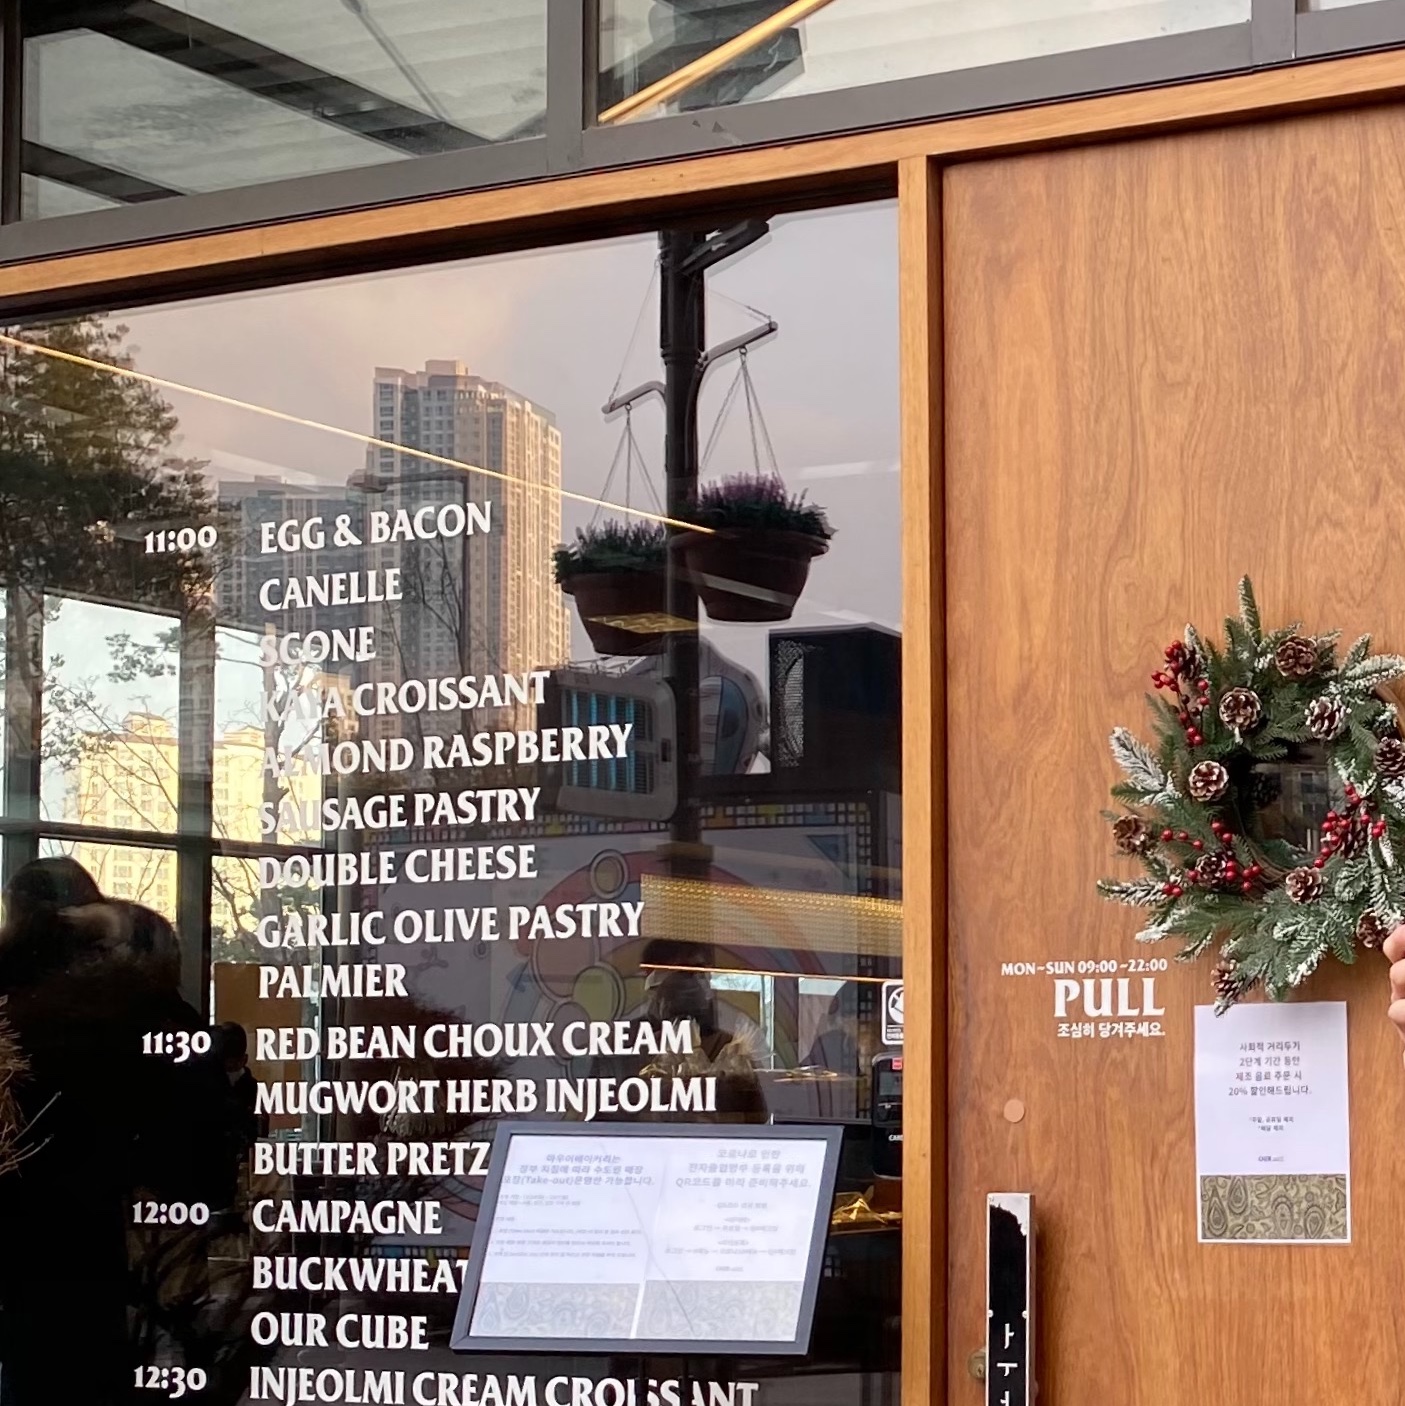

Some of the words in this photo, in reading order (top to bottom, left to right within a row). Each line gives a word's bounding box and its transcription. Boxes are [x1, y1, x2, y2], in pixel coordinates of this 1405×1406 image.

[144, 525, 217, 554] 11:00
[260, 517, 324, 554] EGG
[333, 514, 361, 546] &
[370, 501, 493, 543] BACON
[258, 568, 403, 611] CANELLE
[259, 626, 376, 667] SCONE
[261, 684, 346, 726] KAYA
[352, 669, 550, 719] CROISSANT
[261, 738, 414, 779] ALMOND
[423, 723, 633, 770] RASPBERRY
[257, 793, 406, 834] SAUSAGE
[414, 787, 541, 829] PASTRY
[257, 852, 396, 889] DOUBLE
[404, 844, 538, 883] CHEESE
[257, 914, 386, 949] GARLIC
[394, 906, 499, 944] OLIVE
[508, 900, 646, 940] PASTRY
[258, 963, 409, 999] PALMIER
[1077, 960, 1118, 975] 09:00
[1053, 977, 1166, 1017] PULL
[142, 1030, 212, 1062] 11:30
[256, 1027, 321, 1061] RED
[327, 1024, 417, 1060] BEAN
[423, 1022, 556, 1059] CHOUX
[562, 1019, 694, 1057] CREAM
[1056, 1022, 1095, 1039] 조심히
[1097, 1022, 1166, 1040] 당겨주세요.
[1239, 1041, 1265, 1052] 사회적
[1266, 1040, 1301, 1052] 거리두기
[1239, 1057, 1262, 1067] 2단계
[1264, 1056, 1282, 1066] 기간
[1274, 1071, 1292, 1080] 주문
[1294, 1070, 1302, 1080] 시
[253, 1079, 441, 1115] MUGWORT
[446, 1079, 539, 1115] HERB
[545, 1076, 718, 1121] INJEOLMI
[1228, 1087, 1248, 1096] 20%
[253, 1140, 378, 1177] BUTTER
[132, 1200, 210, 1226] 12:00
[252, 1198, 443, 1236] CAMPAGNE
[250, 1310, 328, 1348] OUR
[335, 1312, 430, 1351] CUBE
[133, 1365, 207, 1399] 12:30
